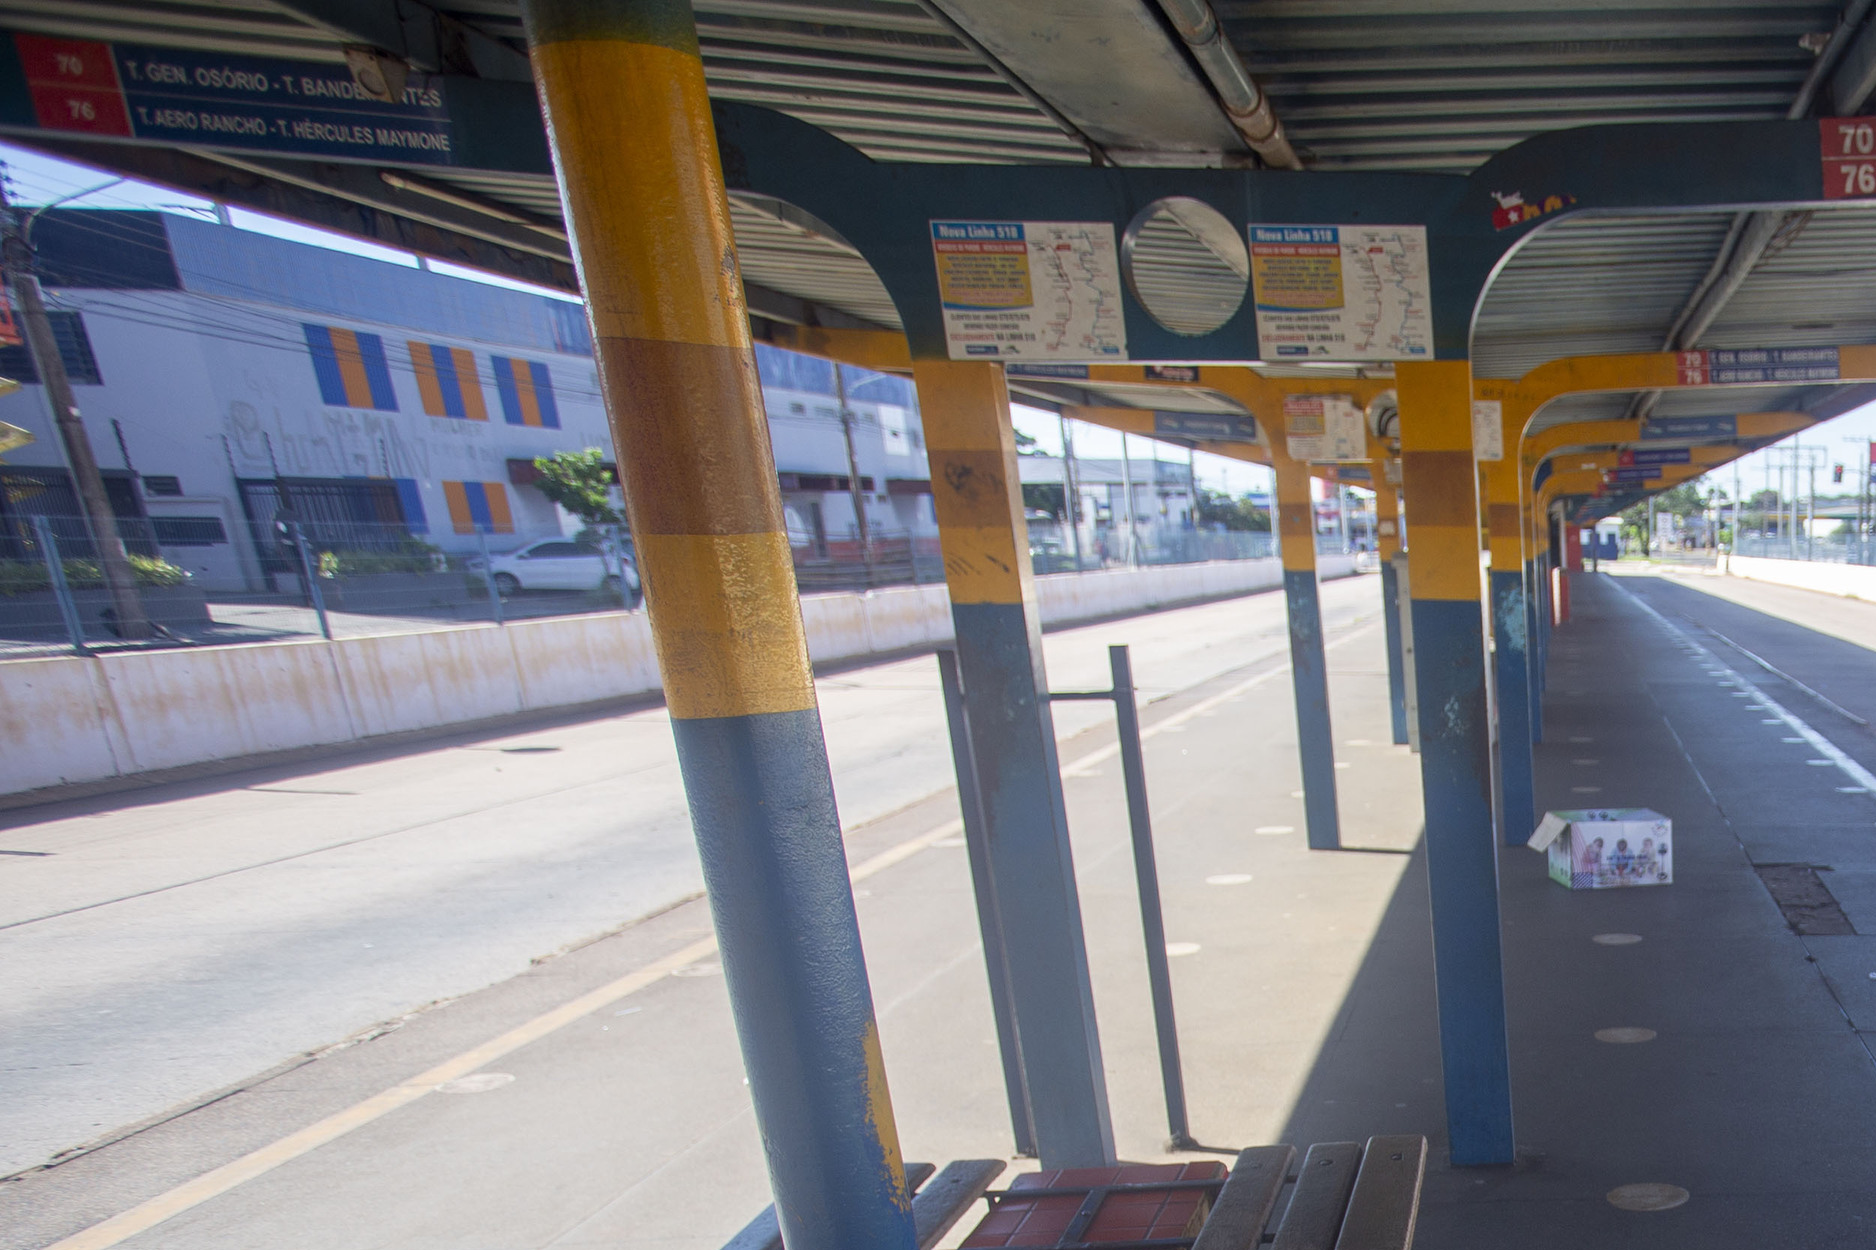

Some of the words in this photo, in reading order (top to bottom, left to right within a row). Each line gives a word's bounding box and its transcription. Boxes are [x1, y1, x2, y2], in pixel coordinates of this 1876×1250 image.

[56, 53, 83, 75] 70
[145, 63, 192, 84] GEN.
[194, 66, 269, 92] OSÓRIO
[67, 100, 95, 121] 76
[155, 108, 198, 130] AERO
[202, 112, 267, 135] RANCHO
[293, 118, 374, 145] HÉRCULES
[376, 128, 450, 151] MAYMONE
[1838, 123, 1874, 154] 70
[1840, 164, 1876, 193] 76
[967, 225, 995, 238] Linha
[1284, 229, 1311, 242] Linha
[1684, 351, 1701, 367] 70
[1685, 369, 1702, 384] 76
